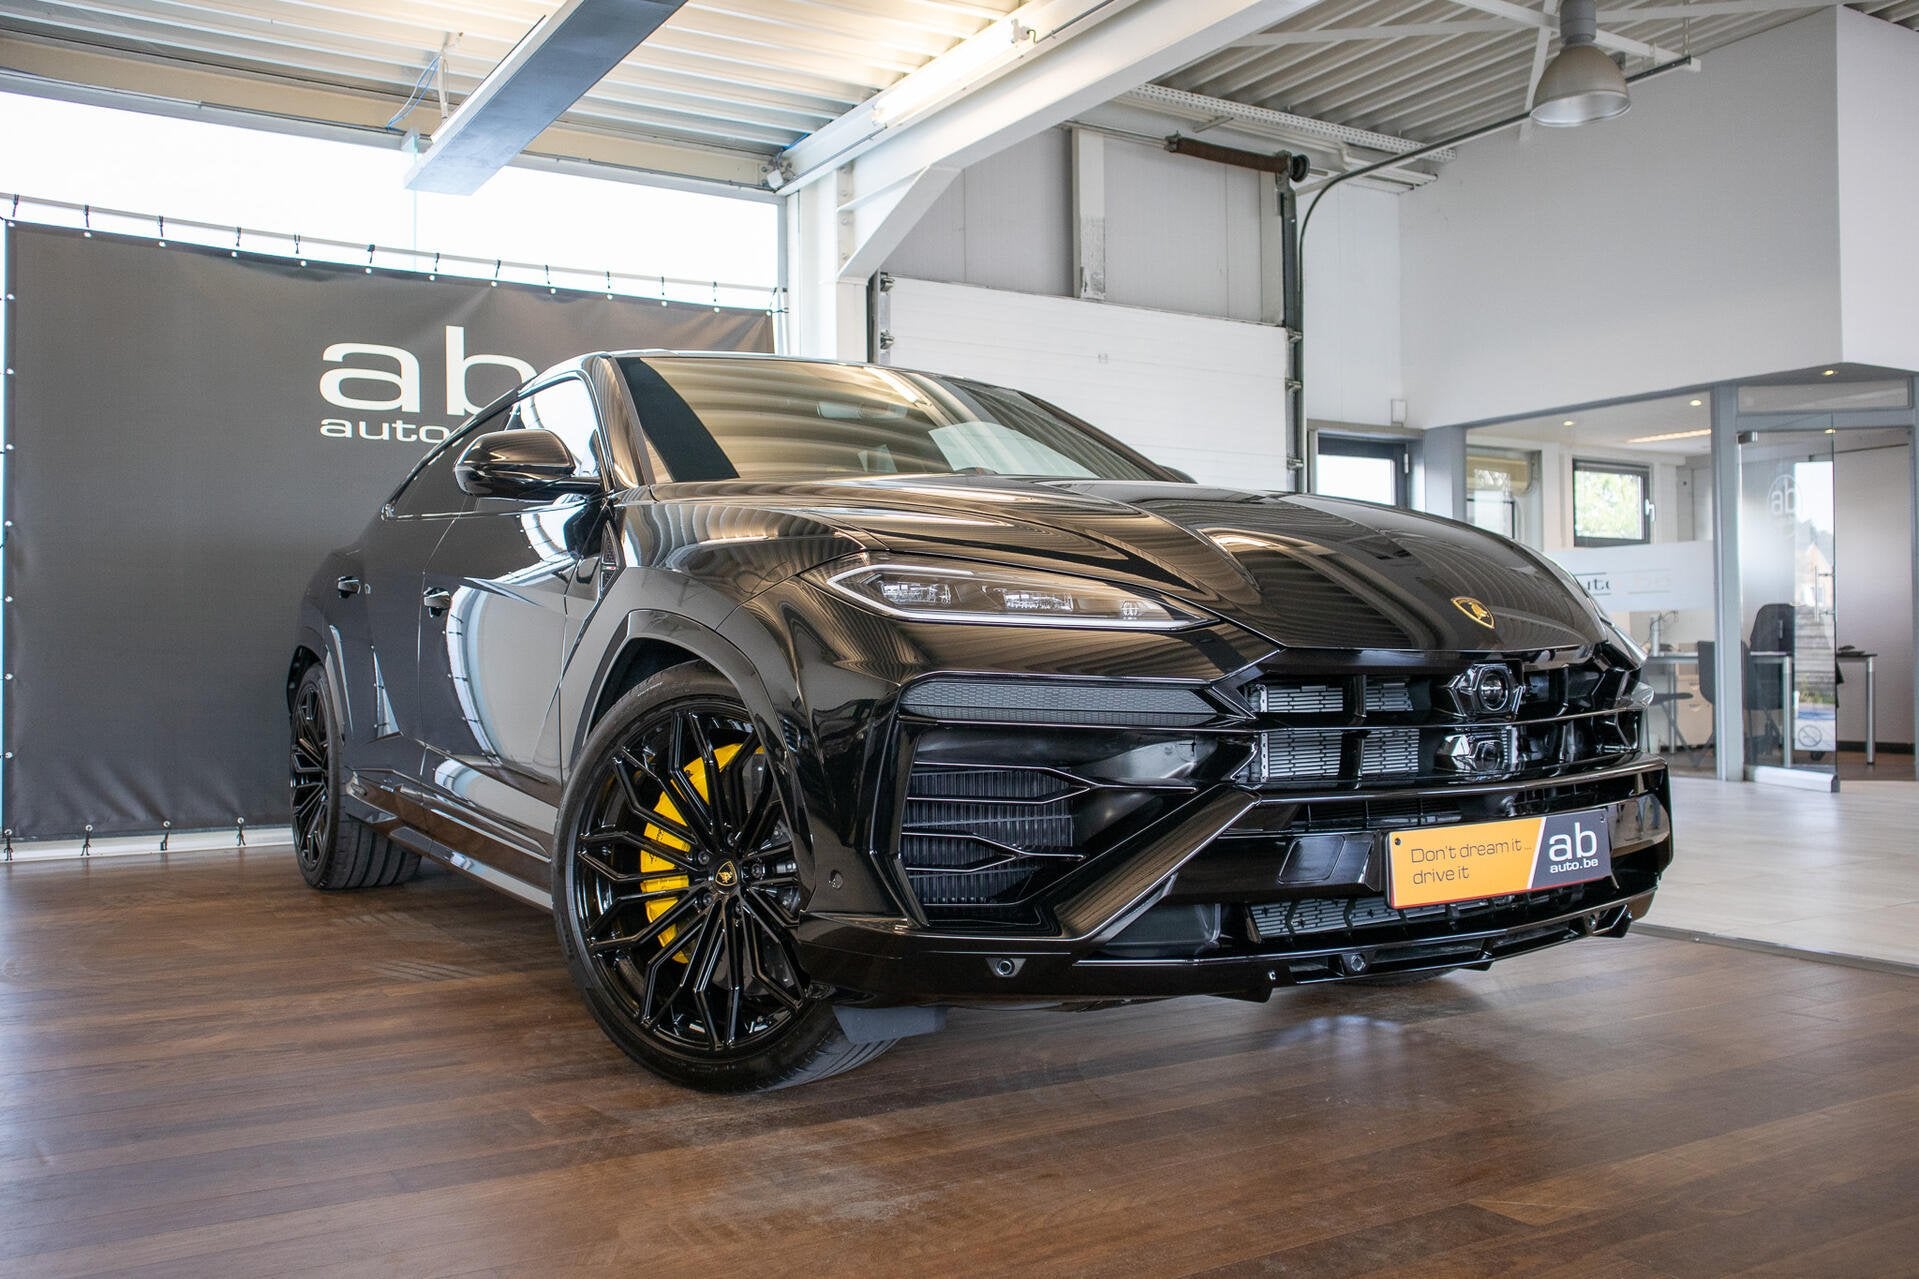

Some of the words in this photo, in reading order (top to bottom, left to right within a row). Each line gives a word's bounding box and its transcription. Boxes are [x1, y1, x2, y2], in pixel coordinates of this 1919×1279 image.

[319, 325, 538, 417] ab
[1411, 845, 1457, 863] Don't
[1459, 840, 1510, 858] dream
[1548, 821, 1598, 862] ab
[1412, 869, 1456, 885] drive
[1457, 865, 1470, 880] it
[1549, 858, 1599, 874] auto.be
